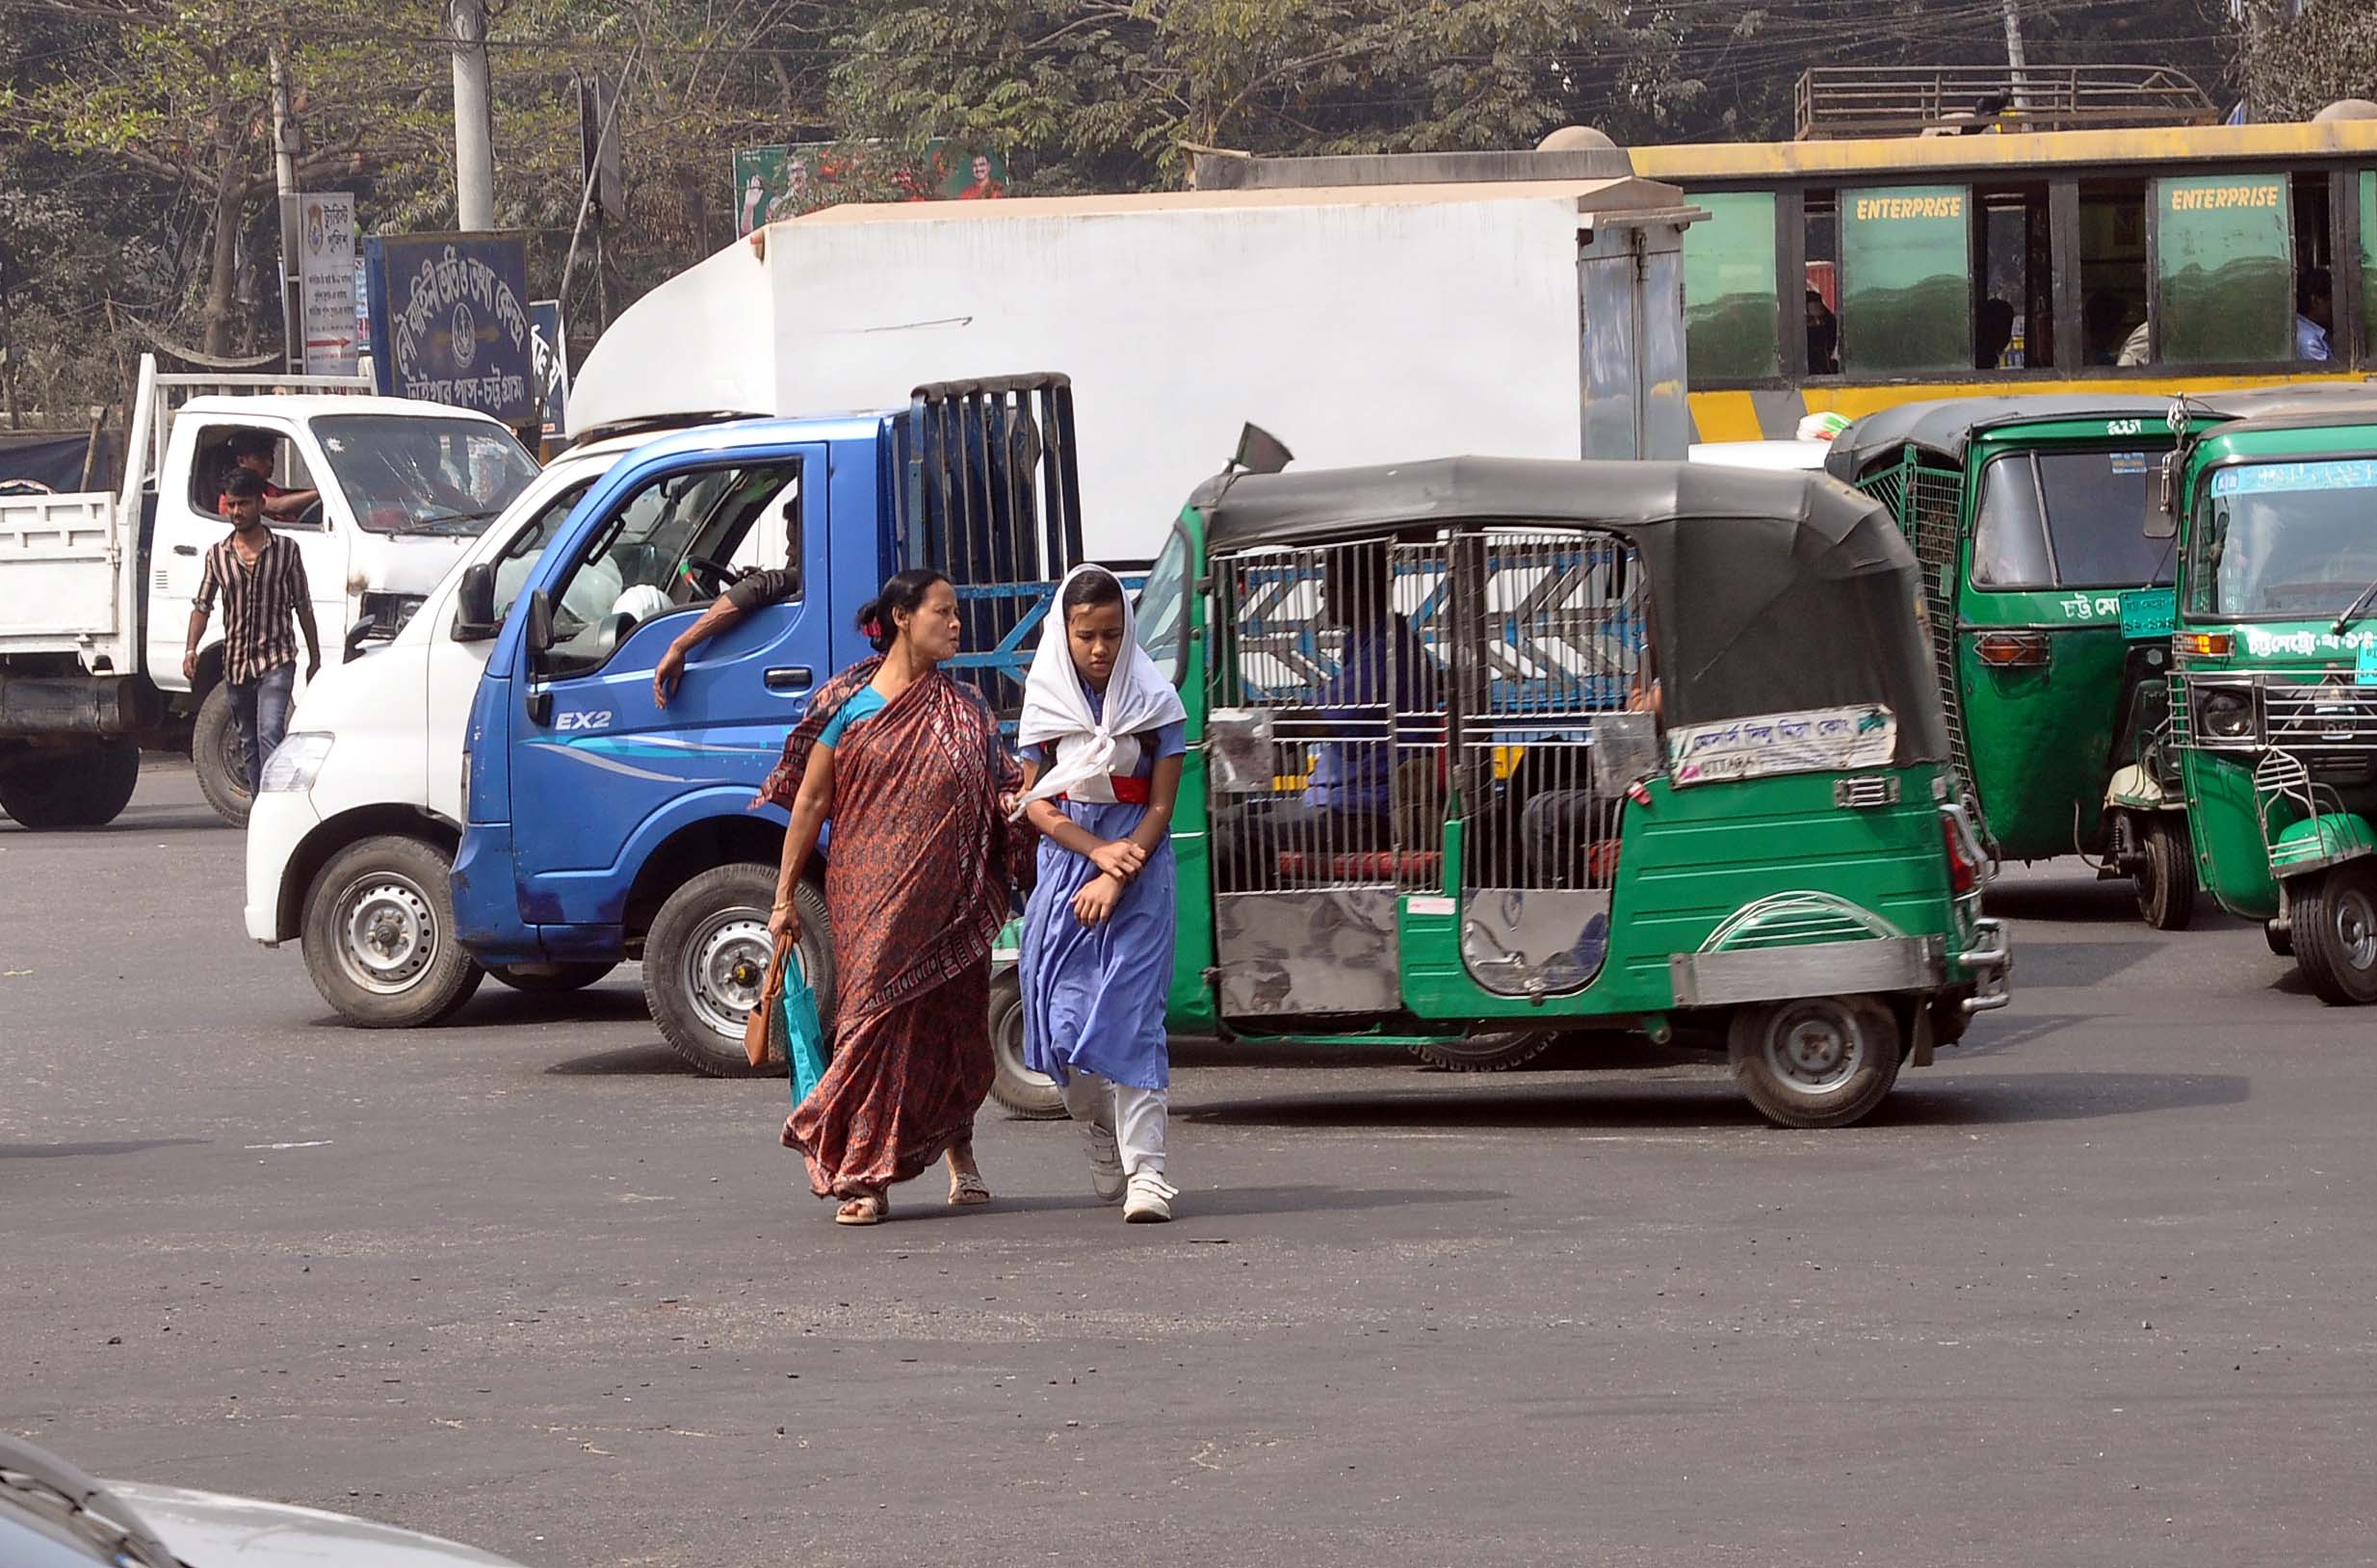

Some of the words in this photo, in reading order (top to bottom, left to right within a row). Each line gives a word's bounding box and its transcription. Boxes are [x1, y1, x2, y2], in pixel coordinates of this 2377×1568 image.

[1857, 196, 1962, 220] ENTERPRISE
[2172, 186, 2279, 210] ENTERPRISE
[555, 711, 613, 730] EX2
